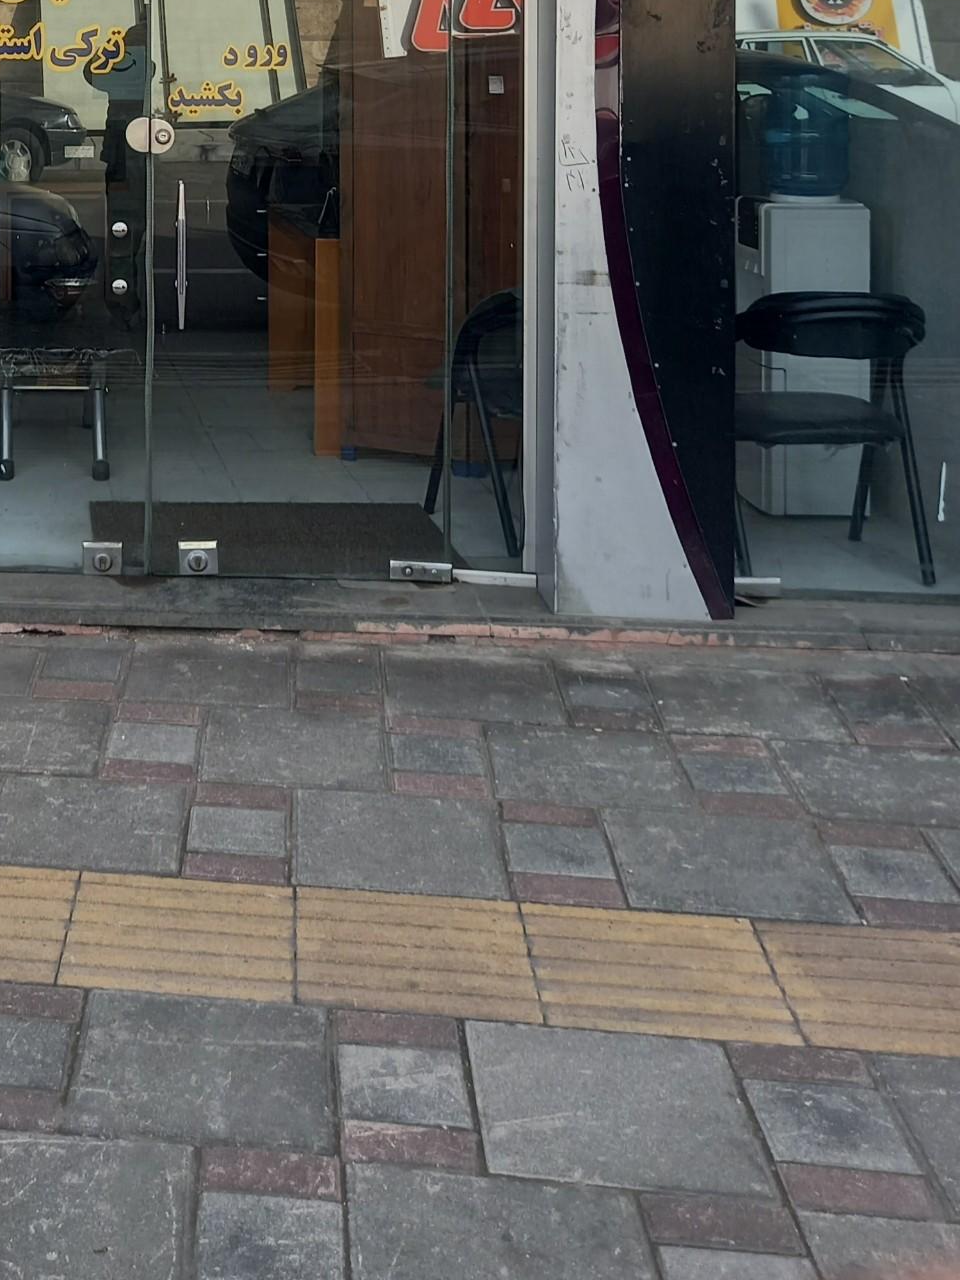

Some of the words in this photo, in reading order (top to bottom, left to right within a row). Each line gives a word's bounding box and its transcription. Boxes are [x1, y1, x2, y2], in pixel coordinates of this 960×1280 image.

[48, 23, 125, 75] ترکی
[221, 43, 289, 70] ورود
[167, 81, 245, 116] بکشید
